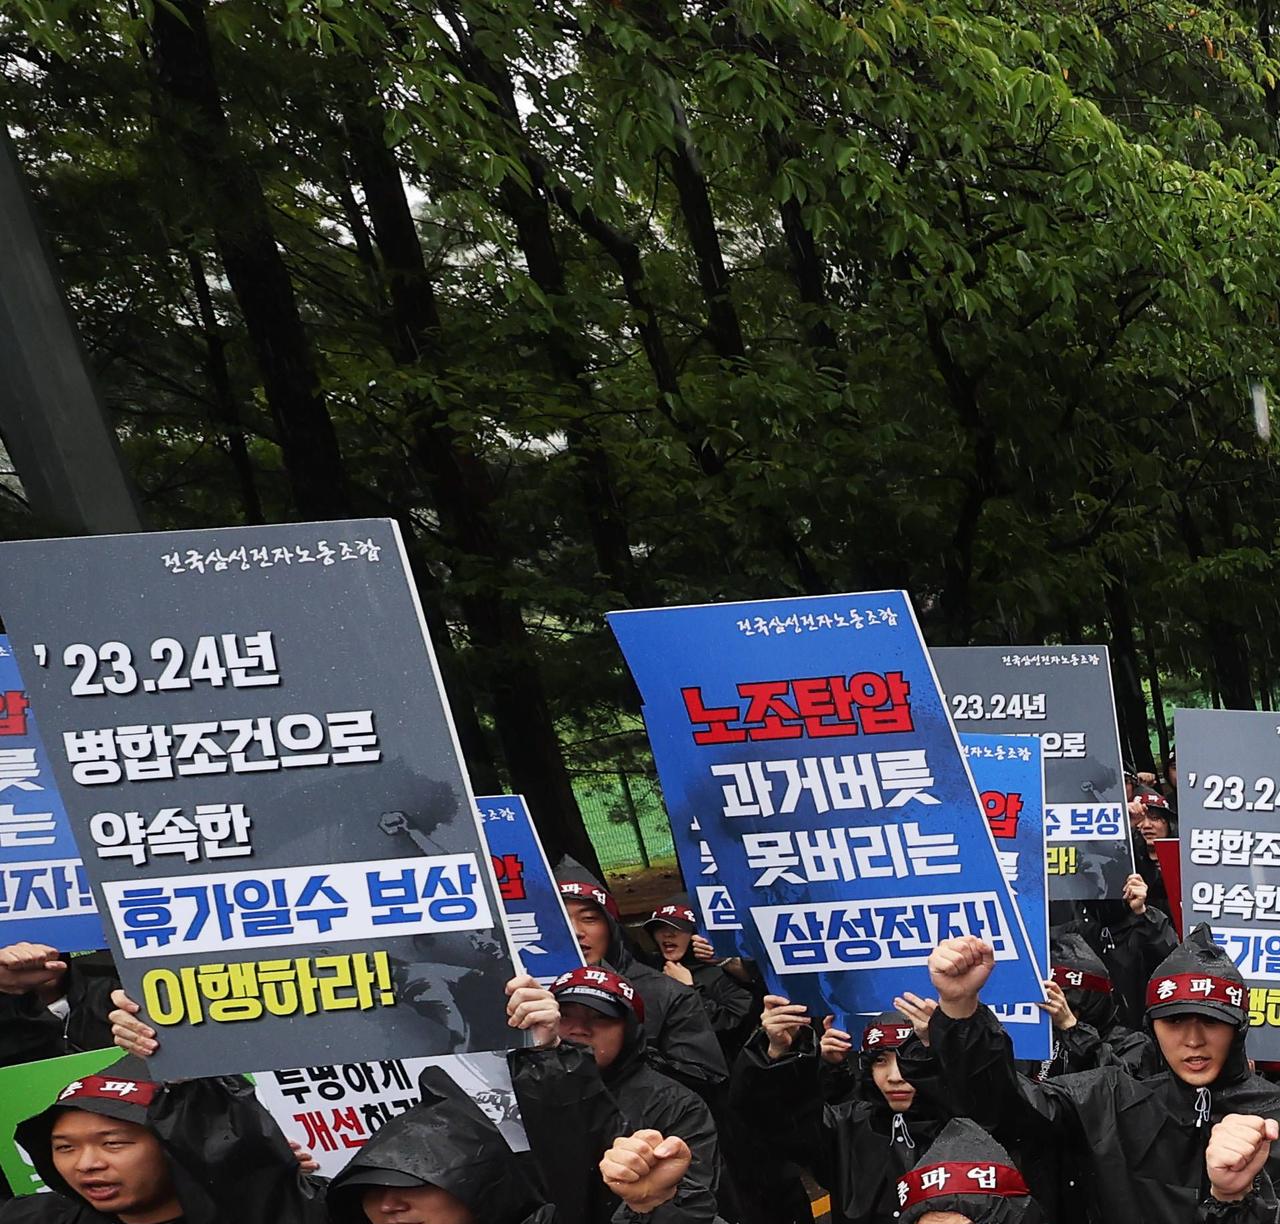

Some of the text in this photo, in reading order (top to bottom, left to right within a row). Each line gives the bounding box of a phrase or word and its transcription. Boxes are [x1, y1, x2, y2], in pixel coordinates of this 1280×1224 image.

[161, 539, 381, 575] 전국삼성전자노동조합
[736, 607, 899, 637] 전국삼성전자노동조합
[1001, 653, 1100, 668] 전국삼성전자노동조합
[681, 671, 916, 746] 노조탄압
[62, 709, 381, 786] 병합조건으로
[710, 748, 943, 819] 과거버릇
[89, 803, 252, 866] 약속한
[1069, 806, 1122, 837] 보상
[742, 824, 963, 889] 못버리는
[119, 871, 348, 950] 휴가일수
[364, 863, 478, 932] 보상
[772, 898, 1005, 964] 삼성전자!
[143, 951, 395, 1027] 이행하라!
